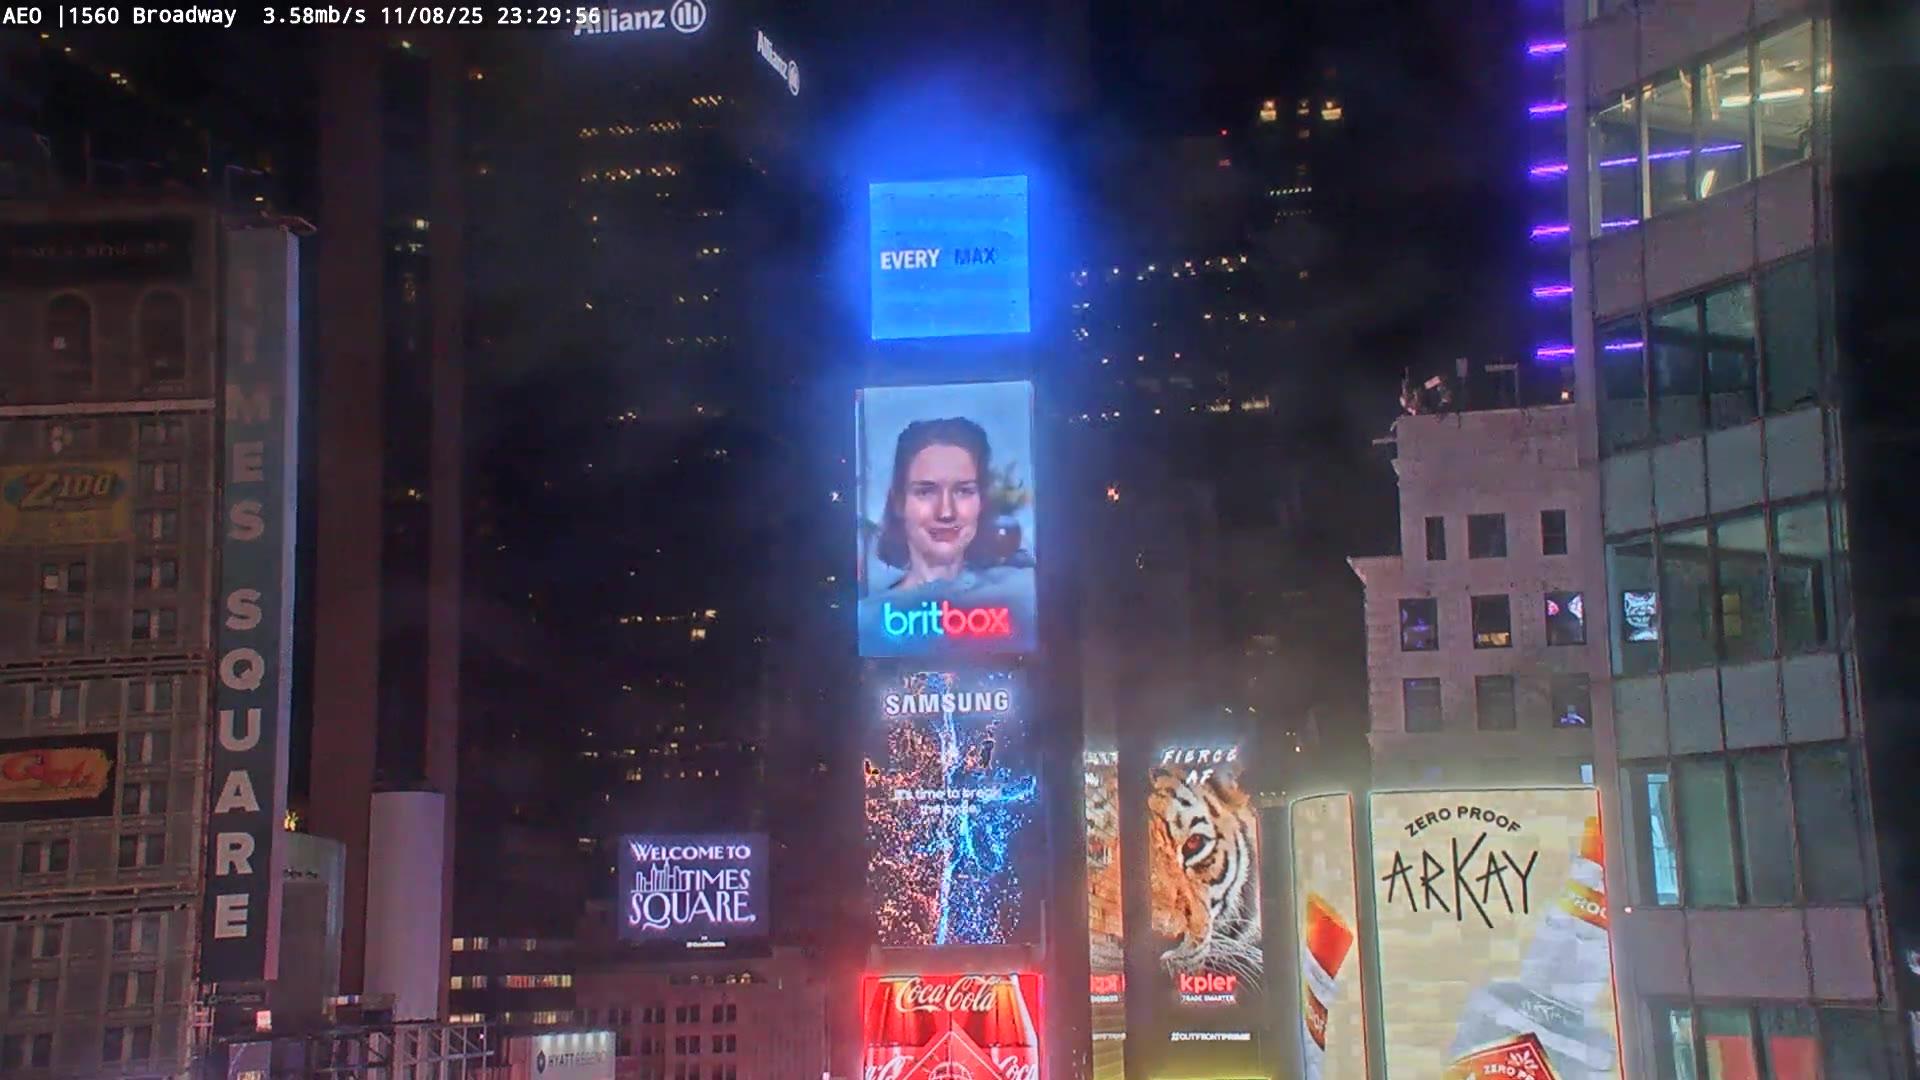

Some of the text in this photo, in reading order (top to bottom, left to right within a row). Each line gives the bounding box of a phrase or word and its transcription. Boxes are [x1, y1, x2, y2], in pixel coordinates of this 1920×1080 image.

[574, 8, 666, 36] Allianz
[880, 248, 996, 270] EVERY MAX
[883, 600, 1010, 636] britbox
[886, 690, 1009, 715] SAMSUNG
[213, 588, 266, 939] SQUARE
[1161, 747, 1240, 766] FIERCE
[1185, 768, 1215, 785] AF
[915, 788, 945, 799] time
[947, 788, 960, 799] to
[1404, 805, 1521, 837] ZERO PROOF
[629, 841, 751, 861] WELCOME TO
[680, 868, 751, 891] TIMES
[1382, 832, 1539, 929] ARKAY
[1180, 972, 1237, 994] kpler
